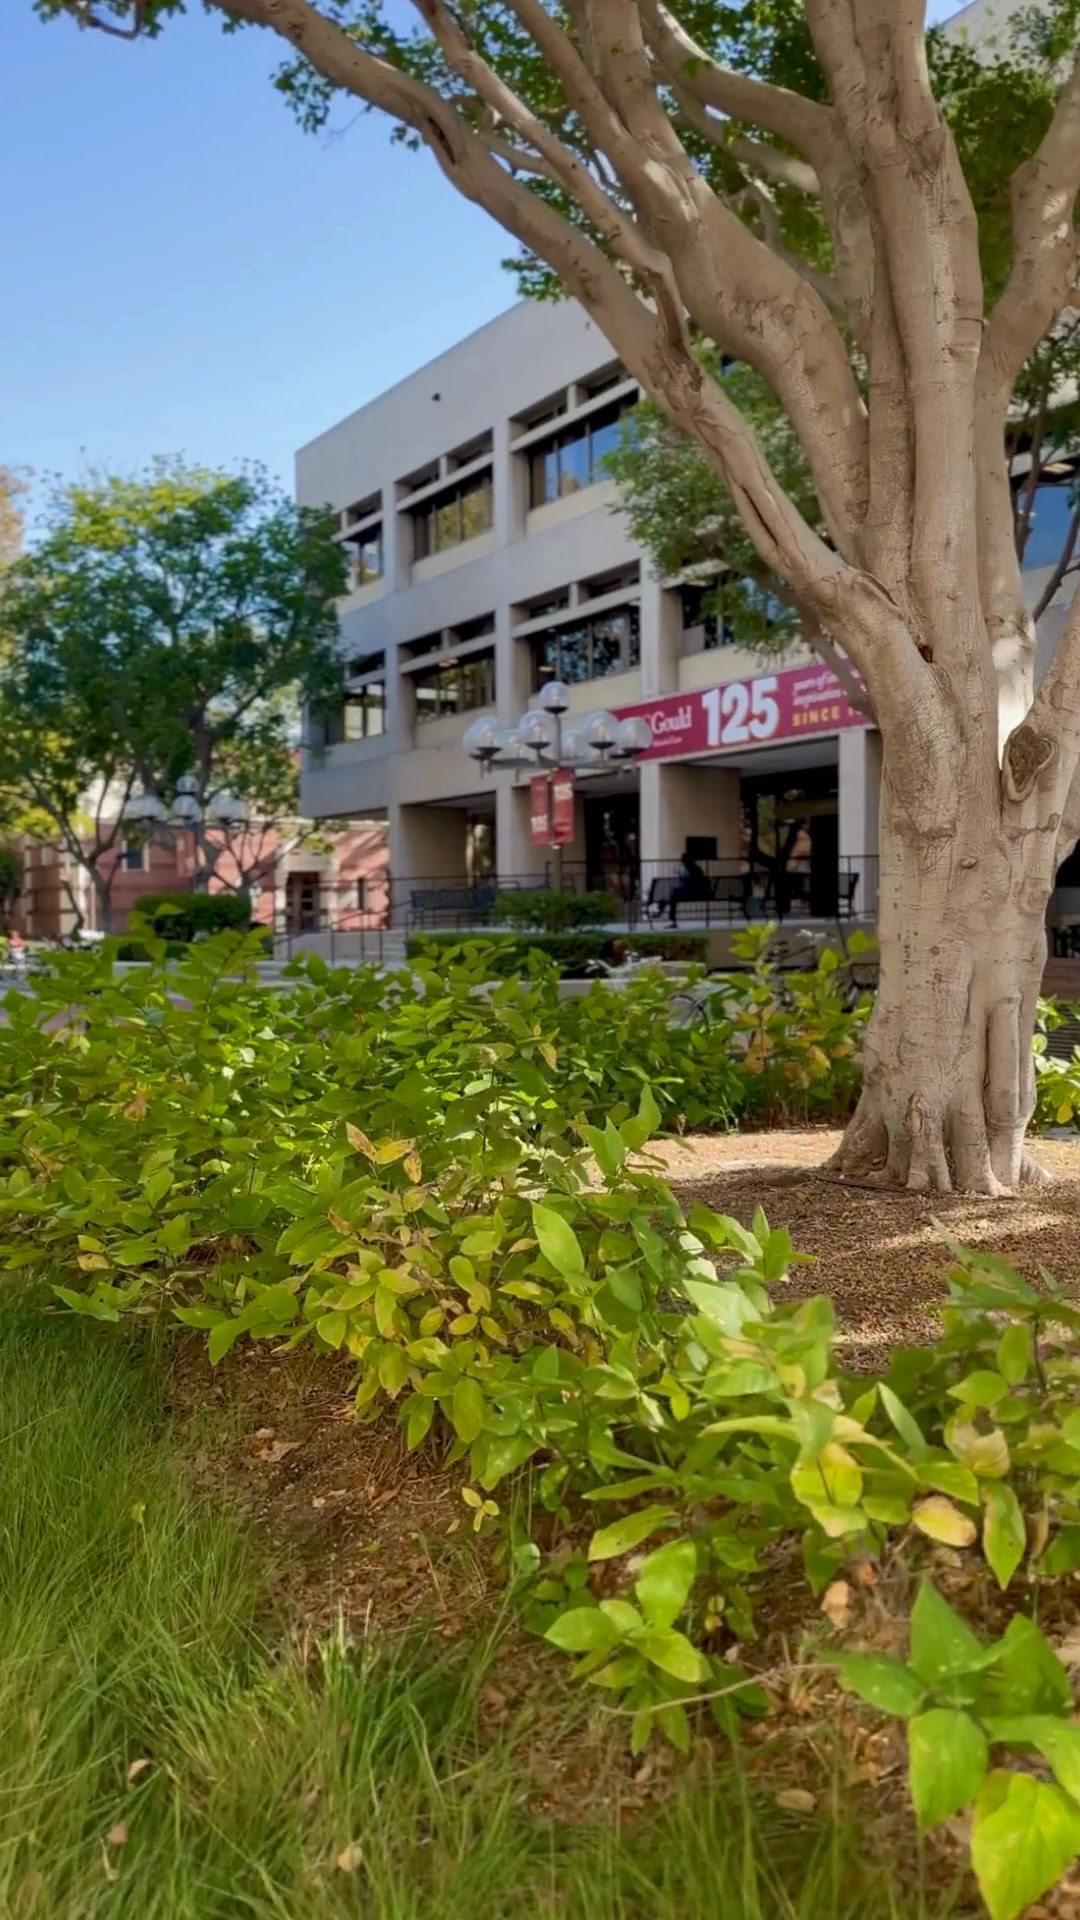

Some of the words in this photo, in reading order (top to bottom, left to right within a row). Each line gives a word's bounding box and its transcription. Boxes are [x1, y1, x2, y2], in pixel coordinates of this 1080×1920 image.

[651, 705, 692, 734] Gould
[702, 676, 779, 746] 125
[792, 706, 839, 727] SINCE
